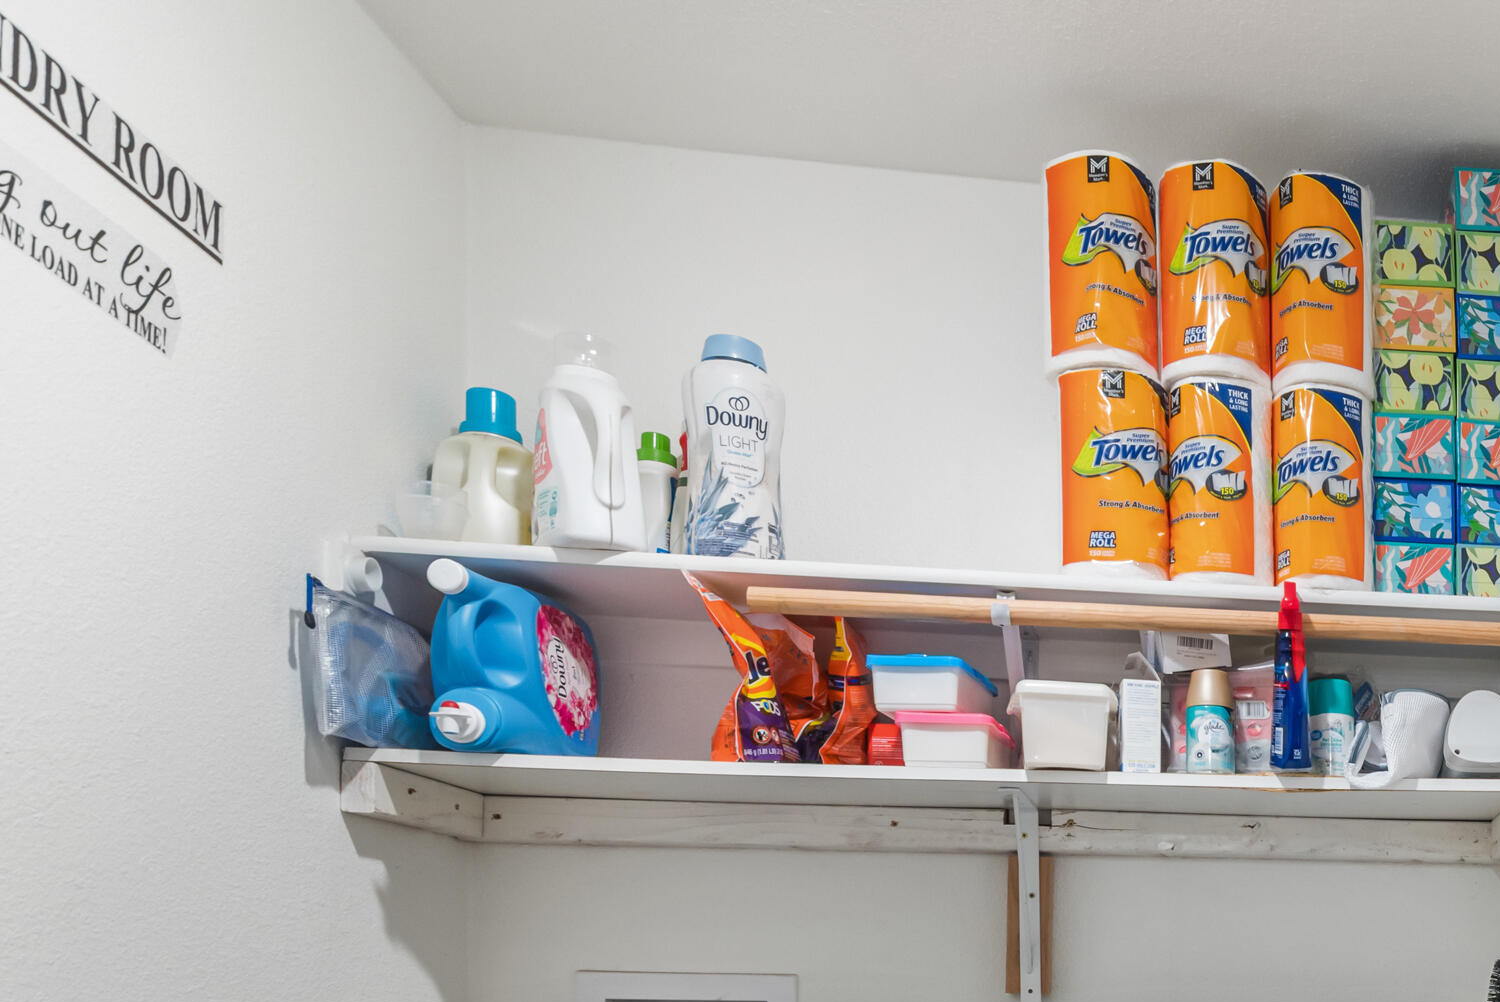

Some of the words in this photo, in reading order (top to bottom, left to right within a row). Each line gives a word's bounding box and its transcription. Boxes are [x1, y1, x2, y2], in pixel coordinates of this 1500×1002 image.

[112, 111, 223, 253] ROOM
[1341, 183, 1359, 196] THICK
[1079, 222, 1148, 256] Towels
[1184, 231, 1255, 265] Towels
[40, 200, 107, 263] out
[120, 245, 181, 320] life
[1276, 237, 1340, 281] Towels
[1334, 280, 1347, 289] 150
[30, 234, 77, 287] LOAD
[82, 277, 104, 306] AT
[108, 296, 120, 320] A
[125, 307, 167, 354] TIME!
[1298, 300, 1333, 311] Absorbent
[1184, 334, 1208, 345] ROLL
[1228, 389, 1248, 400] THICK
[1229, 404, 1248, 413] LASTING
[1342, 397, 1360, 409] THICK
[706, 405, 768, 440] Downy
[720, 435, 758, 452] LIGHT
[1170, 445, 1224, 480] owels
[1278, 450, 1340, 490] Towels
[1220, 487, 1234, 495] 150
[1336, 493, 1347, 501] 150
[1099, 500, 1123, 508] Strong
[1300, 514, 1335, 523] Absorbent
[1090, 531, 1116, 540] MEGA
[1089, 538, 1116, 547] ROLL
[553, 637, 567, 698] Downy
